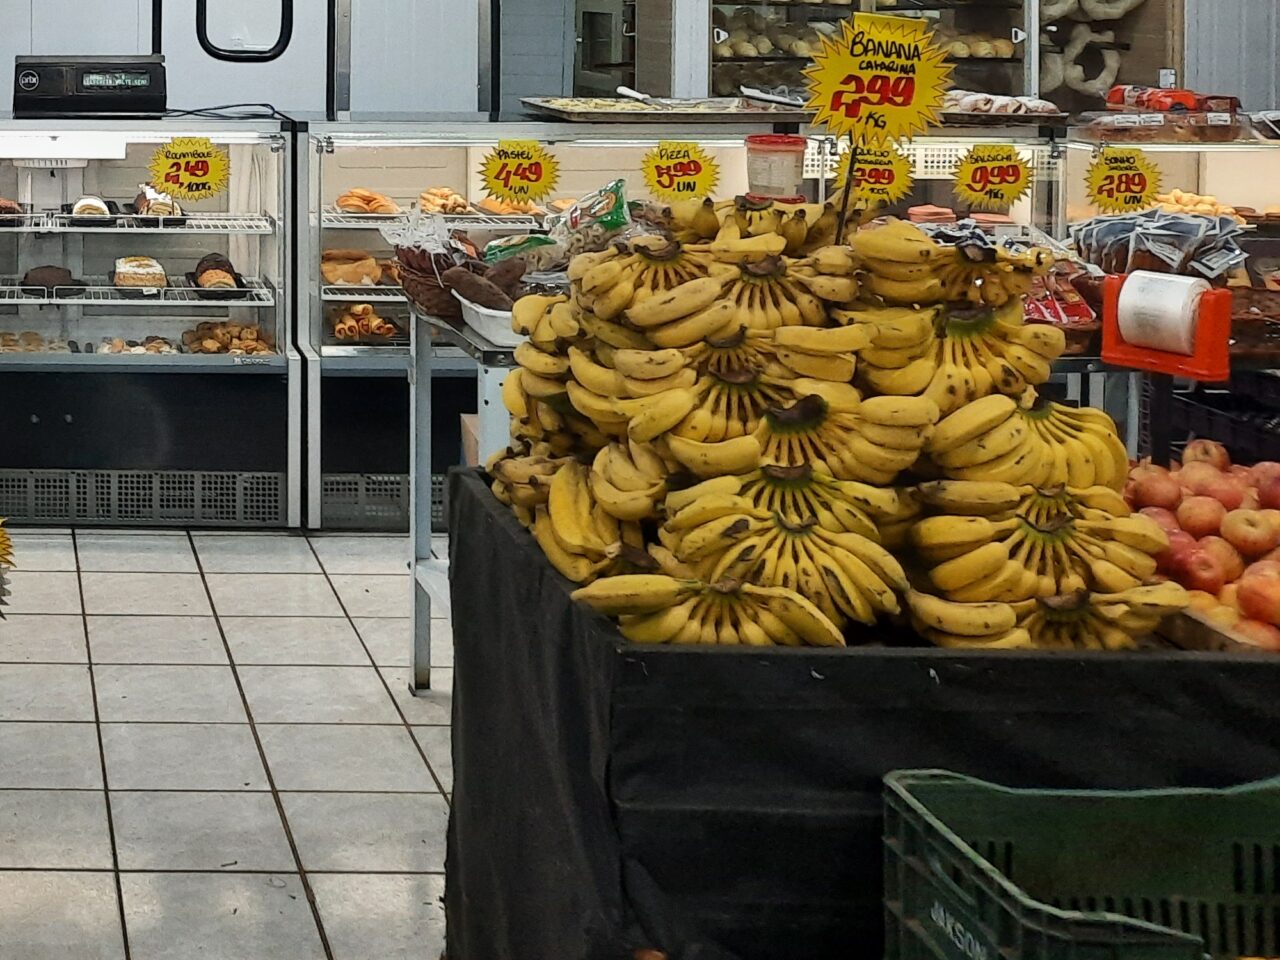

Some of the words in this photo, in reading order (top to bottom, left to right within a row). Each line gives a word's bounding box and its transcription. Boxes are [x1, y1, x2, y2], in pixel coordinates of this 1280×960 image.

[850, 31, 922, 61] BANANA
[858, 60, 916, 75] CATARINA
[865, 111, 887, 130] KG
[166, 150, 213, 160] ROCAMBOLE
[498, 149, 533, 161] PASTEL
[660, 148, 690, 161] PIZZA
[513, 185, 529, 195] UN
[677, 181, 696, 192] UN
[1123, 194, 1142, 205] UN
